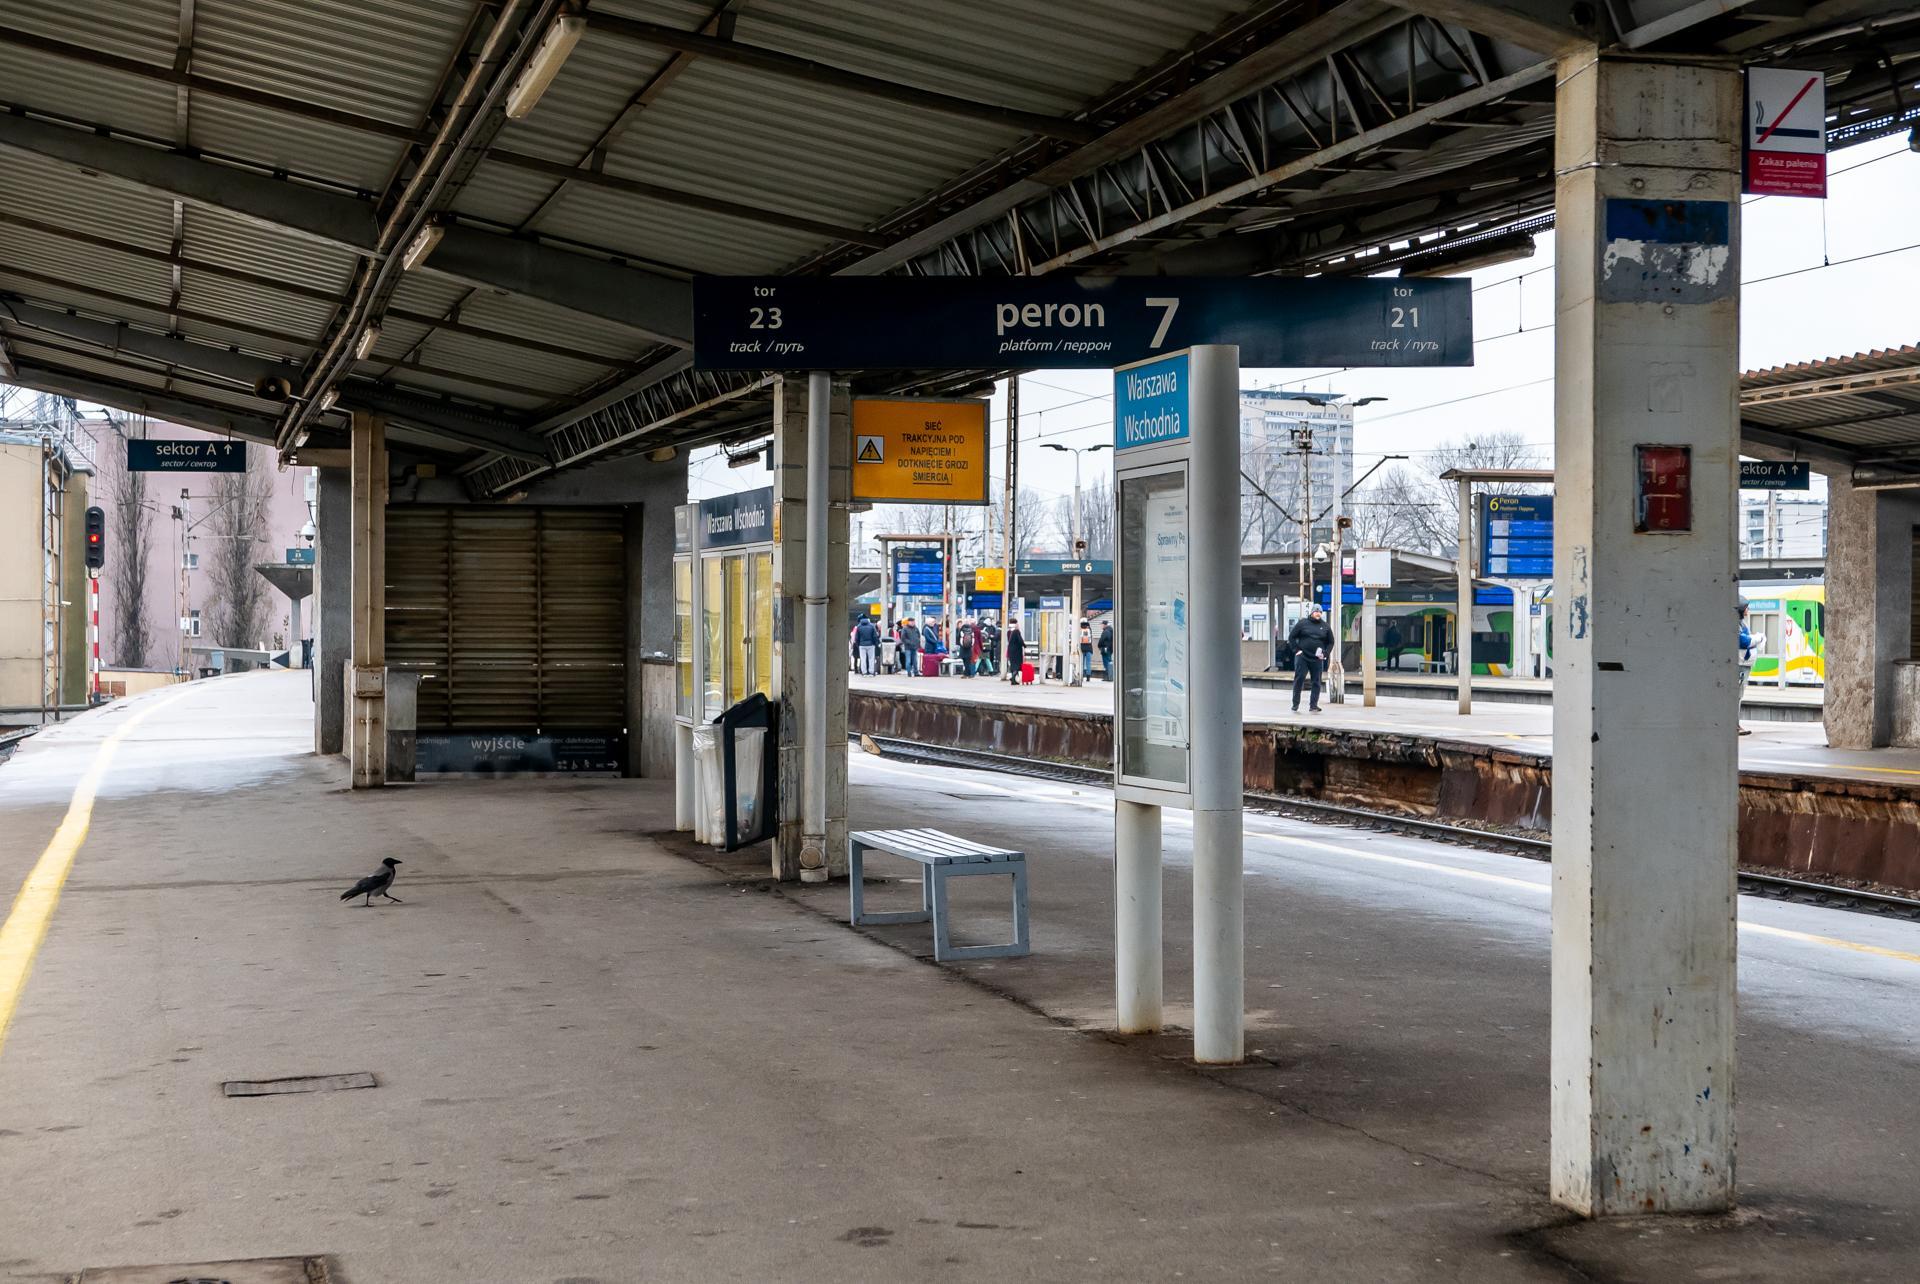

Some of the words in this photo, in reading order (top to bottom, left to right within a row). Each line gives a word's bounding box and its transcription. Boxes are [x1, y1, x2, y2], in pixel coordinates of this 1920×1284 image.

[1759, 157, 1785, 167] Zakaz
[1786, 159, 1818, 169] palenia
[754, 286, 776, 297] tor
[1393, 286, 1414, 297] tor
[750, 307, 783, 329] 23
[996, 303, 1105, 336] peron
[1145, 297, 1180, 349] 7
[1391, 307, 1419, 328] 21
[730, 341, 761, 353] track
[999, 339, 1053, 354] platform
[1063, 342, 1112, 354] перрон
[1371, 339, 1400, 351] track
[1126, 371, 1177, 401] Warszawa
[924, 420, 942, 431] SIEĆ
[1124, 406, 1180, 442] Wschodnia
[902, 433, 948, 444] TRAKCYJNA
[949, 435, 965, 444] POD
[156, 442, 200, 455] sektor
[206, 443, 217, 455] A
[910, 447, 952, 458] NAPIĘCIEM
[898, 459, 943, 470] DOTKNIĘCIE
[945, 460, 968, 470] GROZI
[1777, 464, 1786, 475] A
[913, 471, 949, 482] ŚMIERCIĄ
[1489, 498, 1499, 511] 6
[706, 513, 733, 534] Warszawa
[734, 504, 765, 530] Wschodnia
[897, 550, 903, 558] 6
[1085, 562, 1093, 572] 6
[471, 737, 526, 752] wyjście
